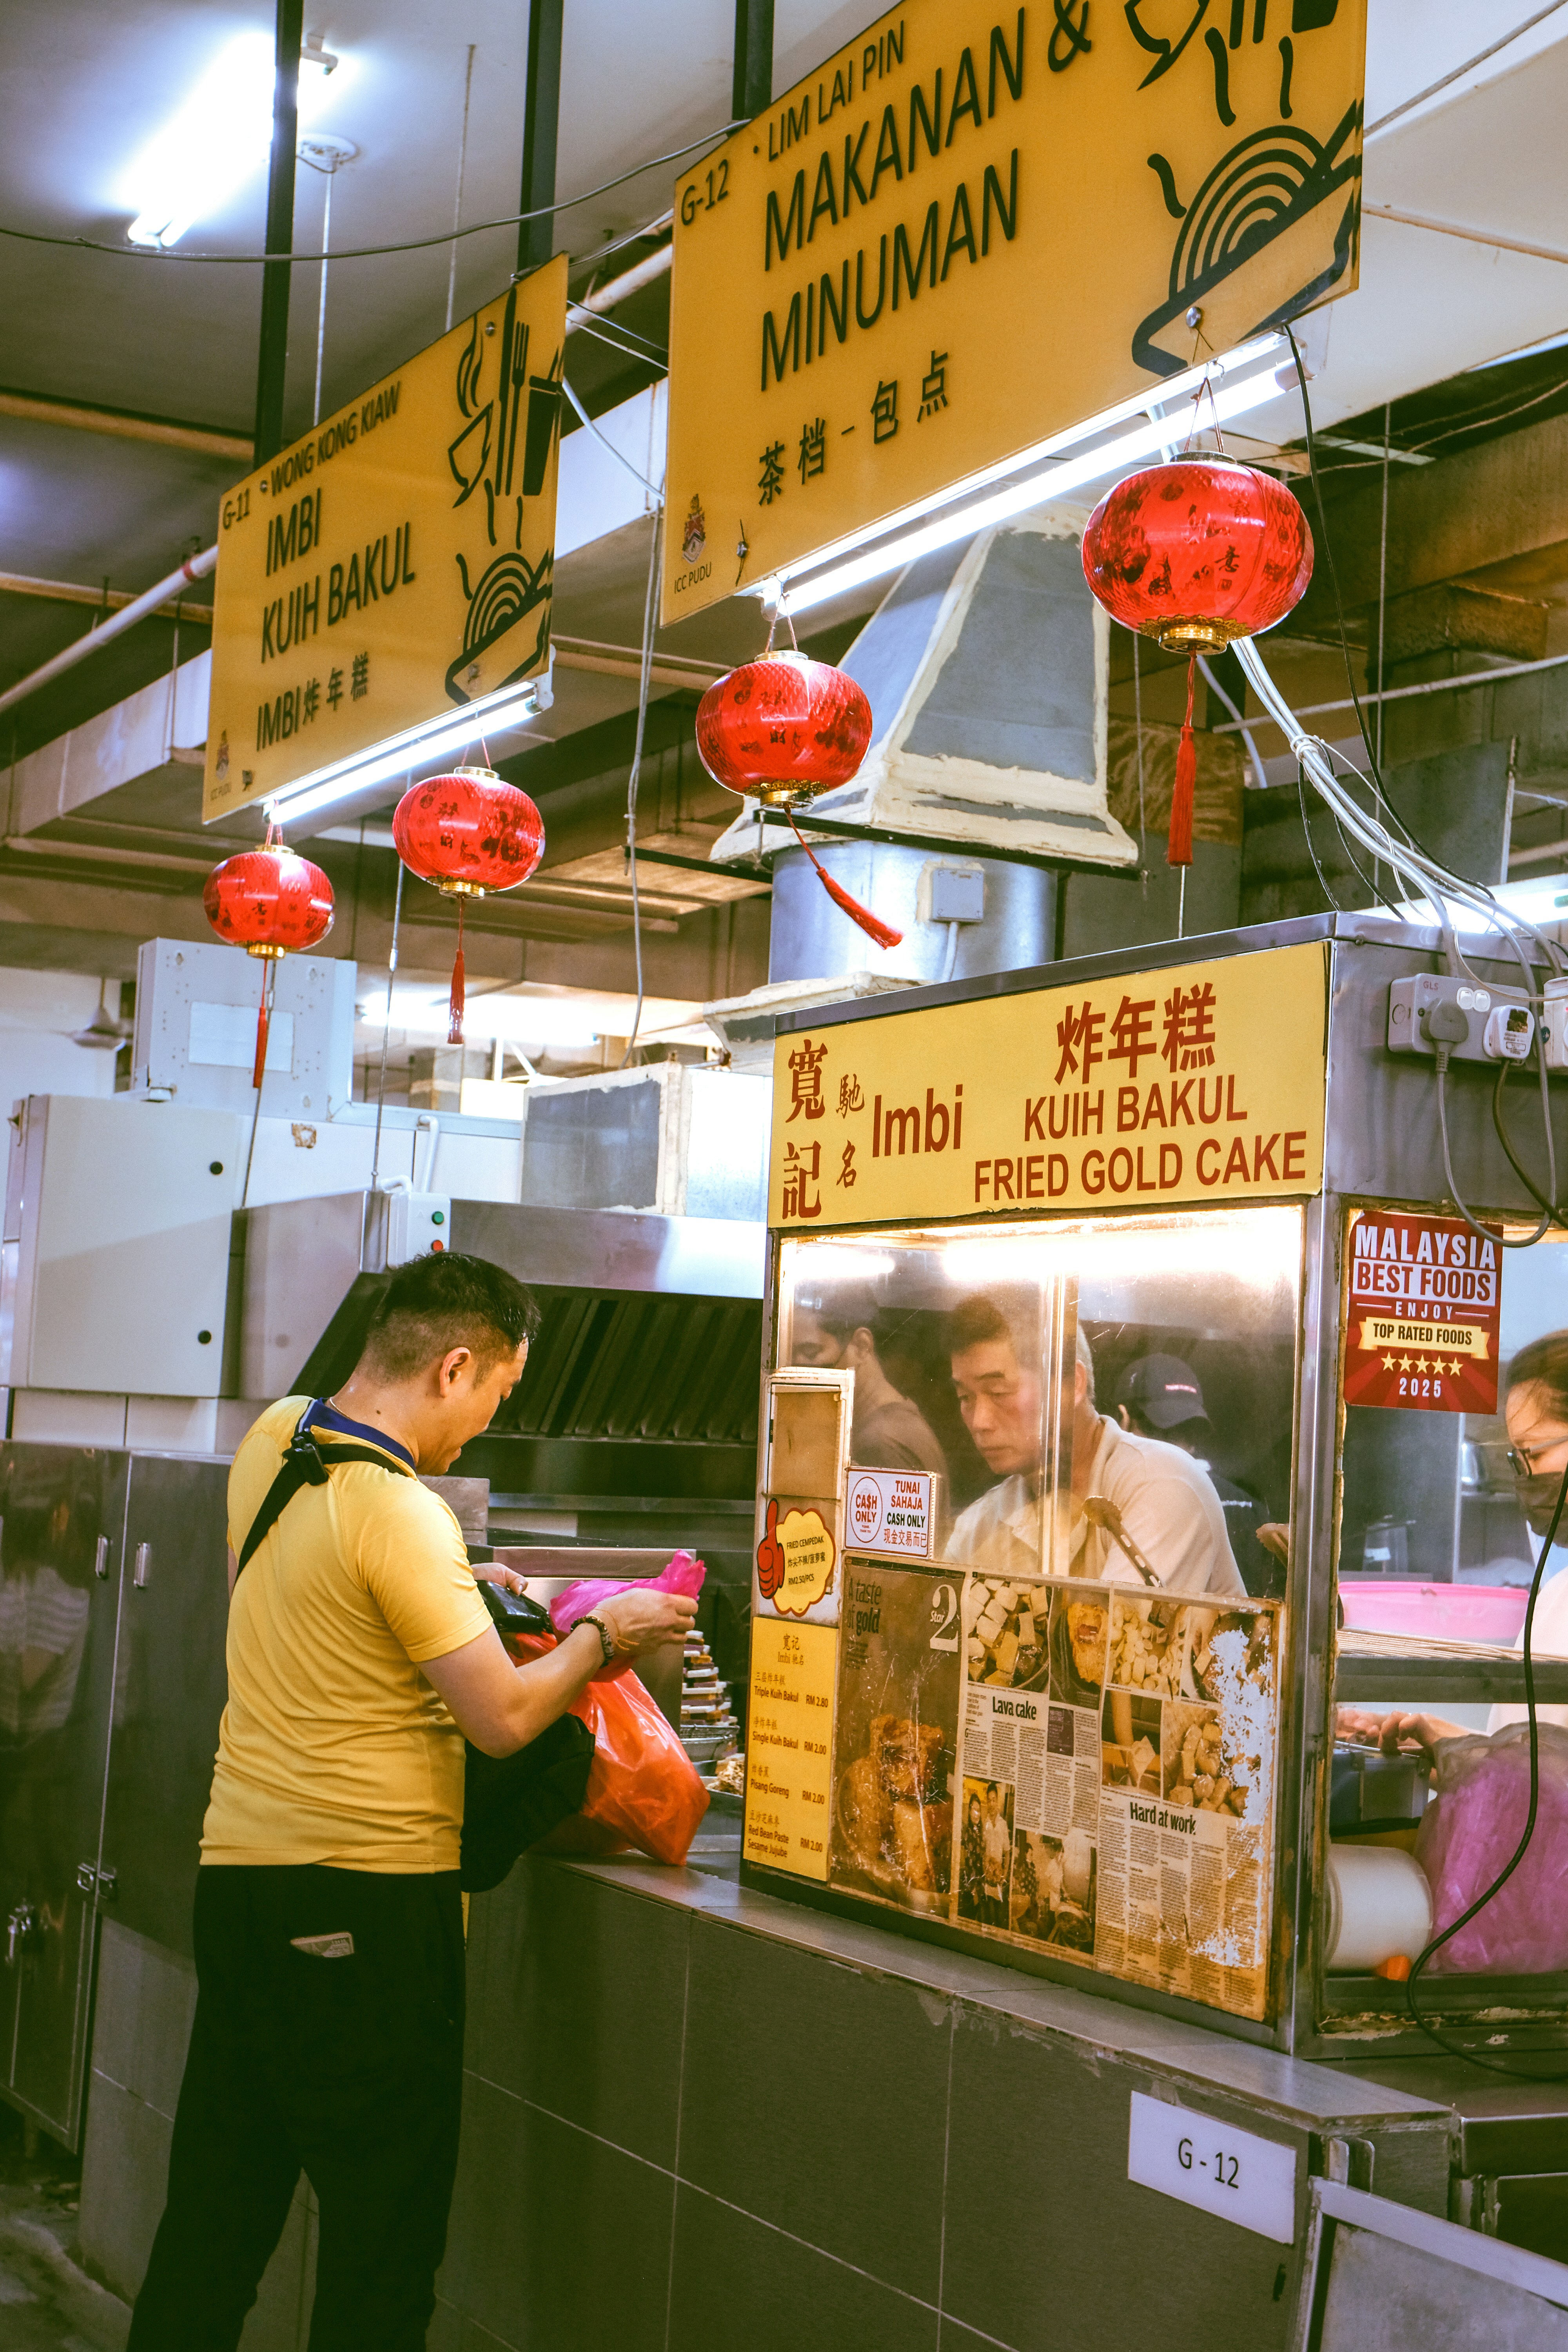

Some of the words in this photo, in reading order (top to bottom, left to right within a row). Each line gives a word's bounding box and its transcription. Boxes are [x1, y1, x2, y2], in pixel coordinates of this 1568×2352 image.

[769, 94, 809, 162] LIM
[818, 60, 852, 124] LAI
[862, 20, 904, 91] PIN
[765, 7, 1025, 272] MAKANAN
[1048, 0, 1091, 72] &
[681, 159, 728, 225] G-12
[761, 147, 1018, 392] MINUMAN
[271, 443, 314, 496] WONG
[317, 412, 358, 466] KONG
[361, 380, 401, 436] KIAW
[223, 488, 250, 529] G-11
[266, 487, 321, 577] IMBI
[674, 575, 687, 594] ICC
[689, 562, 711, 587] PUDU
[261, 575, 320, 664] KUIH
[327, 521, 415, 626] BAKUL
[1423, 981, 1438, 991] GLS
[1054, 982, 1216, 1085] 炸年糕
[1024, 1089, 1104, 1142] KUIH
[1117, 1074, 1247, 1132] BAKUL
[872, 1084, 963, 1158] Imbi
[975, 1153, 1069, 1203] FRIED
[1081, 1143, 1182, 1196] GOLD
[1196, 1131, 1307, 1186] CAKE
[1355, 1225, 1496, 1270] MALAYSIA
[1357, 1261, 1414, 1294] BEST
[1420, 1267, 1491, 1301] FOODS
[1395, 1301, 1454, 1320] ENJOY
[1373, 1323, 1394, 1338] TOP
[1398, 1325, 1433, 1342] RATED
[1436, 1328, 1472, 1345] FOODS
[1399, 1377, 1442, 1398] 2025
[895, 1480, 920, 1494] TUNAI
[891, 1495, 923, 1510] SAHAJA
[855, 1510, 877, 1523] ONLY
[887, 1512, 905, 1526] CASH
[907, 1514, 926, 1528] ONLY
[787, 1541, 799, 1550] FRIED
[799, 1536, 824, 1547] CEMPEDAK
[884, 1528, 927, 1548] 现金交易而已
[788, 1573, 815, 1585] RM2.50/PCS
[855, 1580, 882, 1605] taste
[847, 1605, 856, 1629] of
[856, 1607, 881, 1636] gold
[930, 1610, 945, 1623] Star
[778, 1651, 790, 1664] Imbi
[754, 1685, 769, 1699] Triple
[770, 1688, 782, 1700] Kuih
[783, 1690, 799, 1702] Bakul
[806, 1694, 815, 1705] RM
[992, 1696, 1014, 1716] Lava
[1016, 1700, 1037, 1720] cake
[753, 1731, 769, 1744] Single
[770, 1735, 782, 1746] Kuih
[783, 1737, 799, 1749] Bakul
[804, 1741, 813, 1752] RM
[815, 1744, 827, 1755] 2.00
[751, 1779, 768, 1794] Pisang
[769, 1783, 789, 1799] Goreng
[802, 1790, 811, 1801] RM
[813, 1793, 825, 1804] 2.00
[1129, 1802, 1156, 1827] Hard
[1158, 1809, 1168, 1828] at
[1170, 1814, 1197, 1835] work
[748, 1824, 759, 1836] Red
[760, 1828, 773, 1840] Bean
[774, 1831, 789, 1844] Paste
[800, 1838, 809, 1848] RM
[810, 1840, 823, 1853] 2.00
[748, 1838, 768, 1853] Sesame
